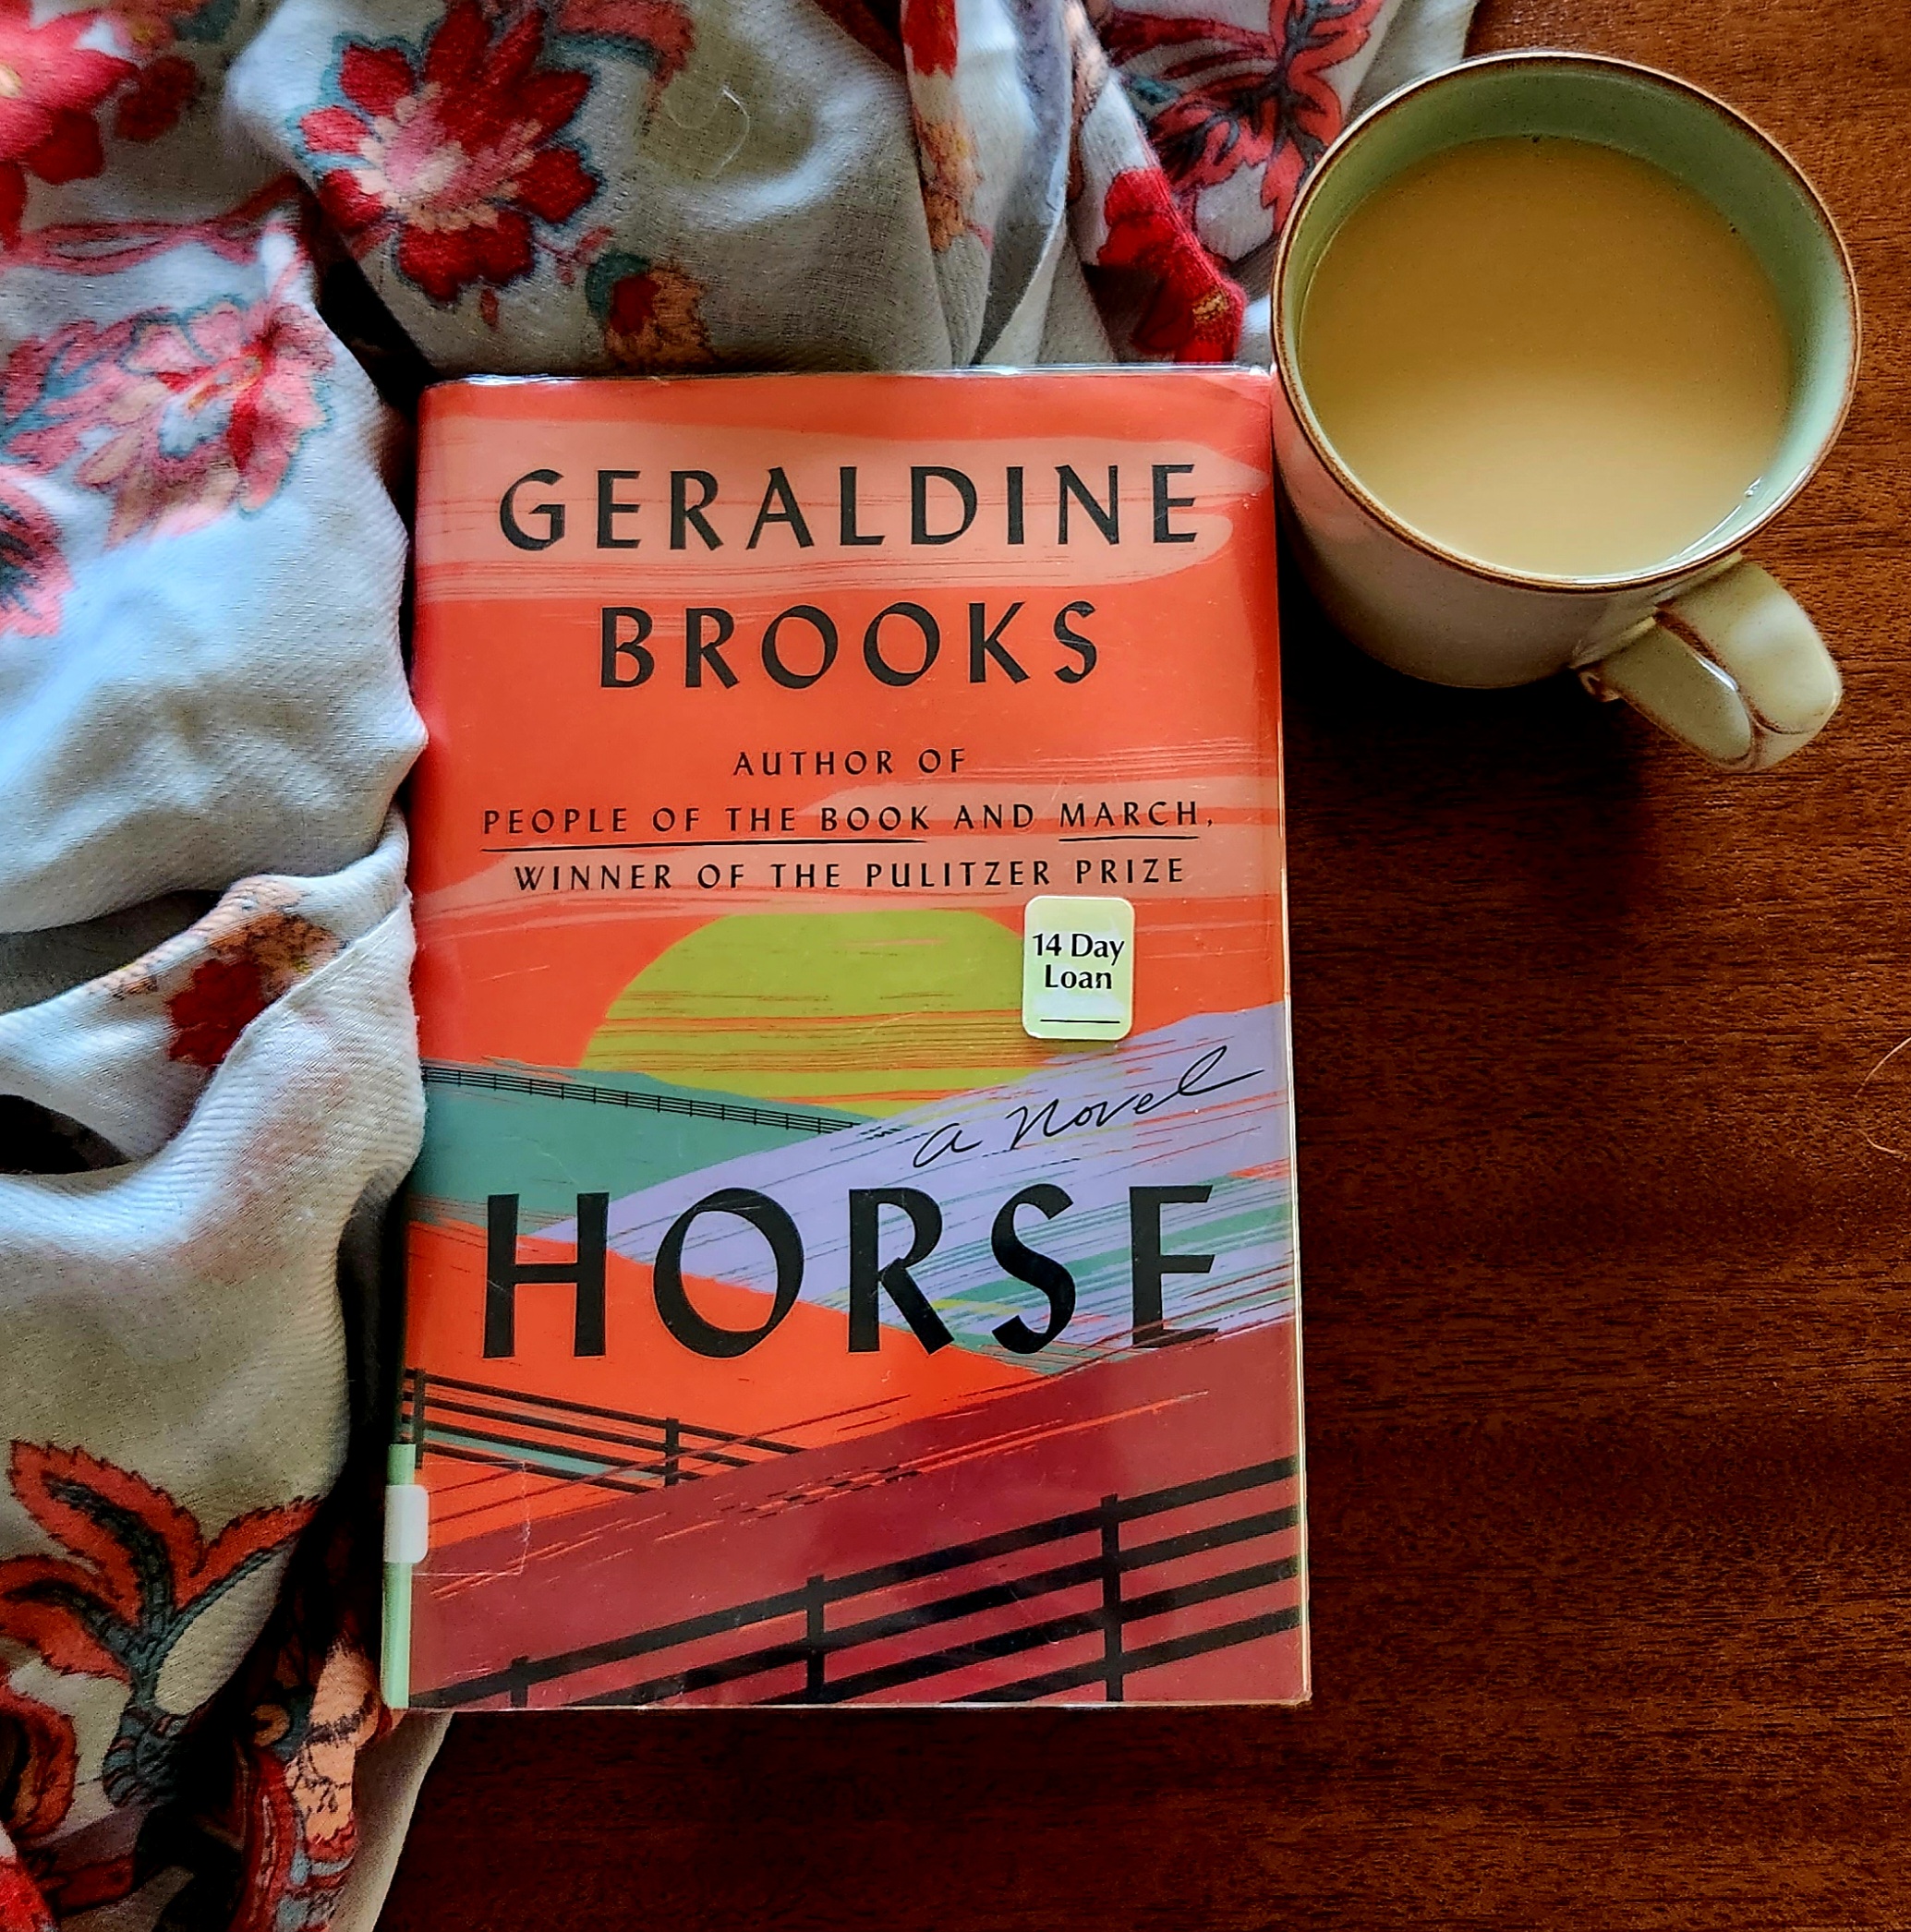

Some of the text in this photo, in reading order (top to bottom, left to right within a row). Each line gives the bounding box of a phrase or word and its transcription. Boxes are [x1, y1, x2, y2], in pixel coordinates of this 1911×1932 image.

[498, 464, 1198, 551] GERALDINE
[599, 600, 1098, 690] BROOKS
[733, 748, 964, 776] AUTHOR OF
[483, 801, 1215, 834] PEOPLE OF THE BOOK AND MARCH,
[514, 858, 1183, 891] WINNER OF THE PULITZER PRIZE
[1032, 933, 1126, 966] 14 Day
[1044, 964, 1113, 990] Loan
[912, 1044, 1265, 1168] a novel
[483, 1183, 1221, 1359] HORSE
